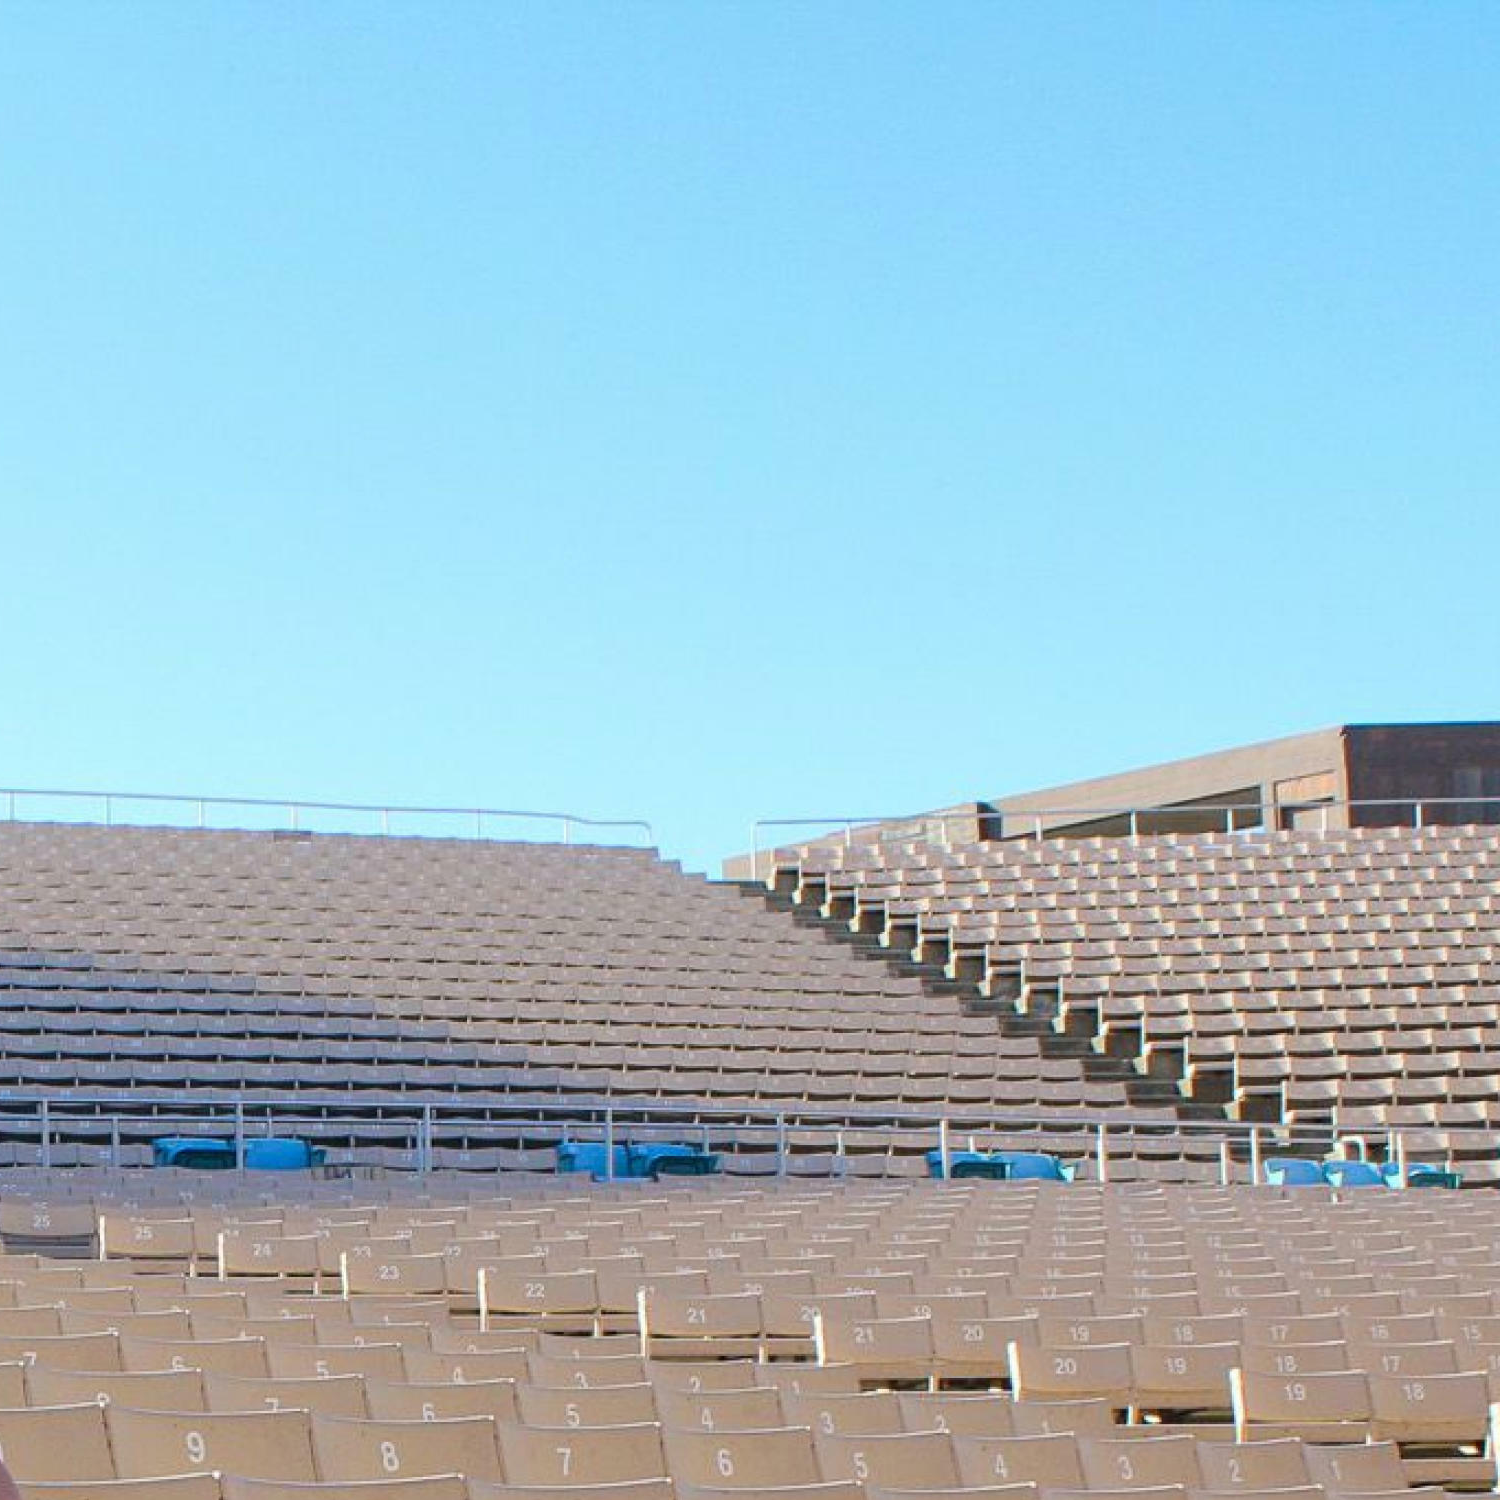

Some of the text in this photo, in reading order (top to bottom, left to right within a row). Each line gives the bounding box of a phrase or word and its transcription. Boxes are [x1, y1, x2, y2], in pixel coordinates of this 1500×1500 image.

[379, 1265, 400, 1281] 23
[524, 1283, 545, 1299] 22
[686, 1306, 706, 1325] 21
[854, 1326, 875, 1345] 21
[962, 1325, 985, 1342] 20
[1068, 1325, 1090, 1343] 19
[1173, 1326, 1195, 1343] 18
[1269, 1325, 1288, 1341] 17
[1369, 1325, 1389, 1340] 16
[1460, 1325, 1482, 1341] 15
[24, 1350, 37, 1367] 7
[1053, 1357, 1076, 1375] 20
[1164, 1357, 1187, 1375] 19
[1275, 1355, 1298, 1373] 18
[1381, 1355, 1401, 1372] 17
[316, 1360, 329, 1377] 5
[1284, 1383, 1306, 1402] 19
[1402, 1383, 1425, 1402] 18
[421, 1403, 436, 1421] 6
[564, 1403, 580, 1427] 5
[701, 1406, 714, 1431] 4
[820, 1411, 835, 1434] 3
[186, 1431, 206, 1464] 9
[379, 1441, 401, 1473] 8
[555, 1447, 572, 1477] 7
[716, 1447, 734, 1478] 6
[852, 1452, 868, 1479] 5
[994, 1454, 1008, 1479] 4
[1117, 1455, 1134, 1481] 3
[1228, 1458, 1244, 1483] 2
[1330, 1459, 1342, 1481] 1
